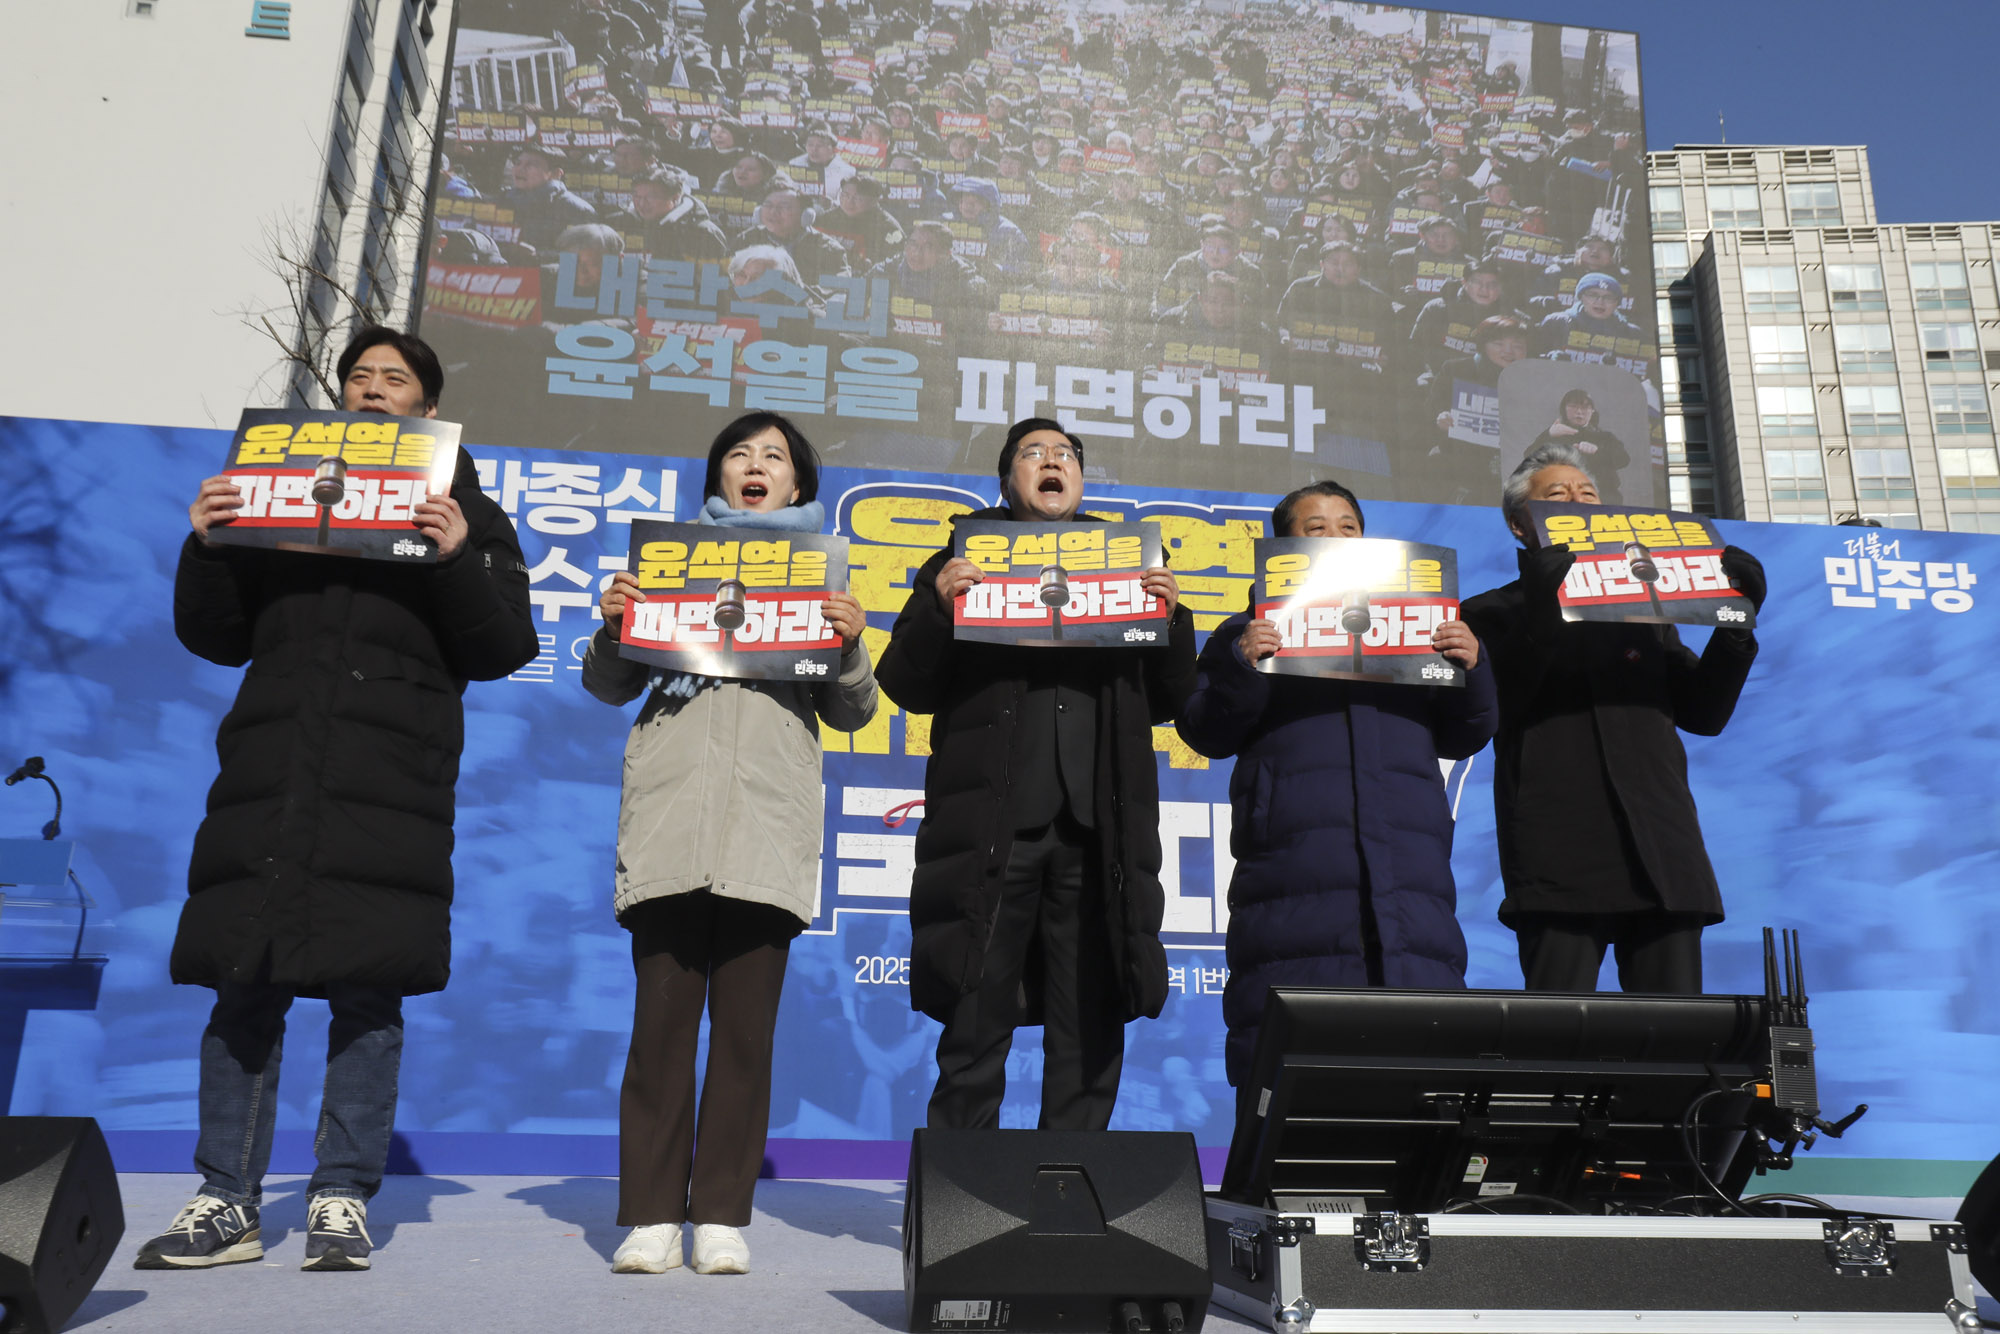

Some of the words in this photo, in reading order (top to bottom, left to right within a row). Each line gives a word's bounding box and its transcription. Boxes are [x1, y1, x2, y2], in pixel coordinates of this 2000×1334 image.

[555, 252, 890, 338] 내란수괴
[545, 325, 924, 422] 윤석열을
[954, 356, 1327, 453] 파면하라
[235, 422, 436, 467] 윤석열을
[964, 530, 1142, 572] 윤석열을
[1544, 513, 1713, 552] 윤석열을
[1843, 532, 1901, 561] 더불어
[638, 540, 827, 588] 윤석열을
[1824, 557, 1977, 613] 민주당
[855, 956, 911, 985] 2025
